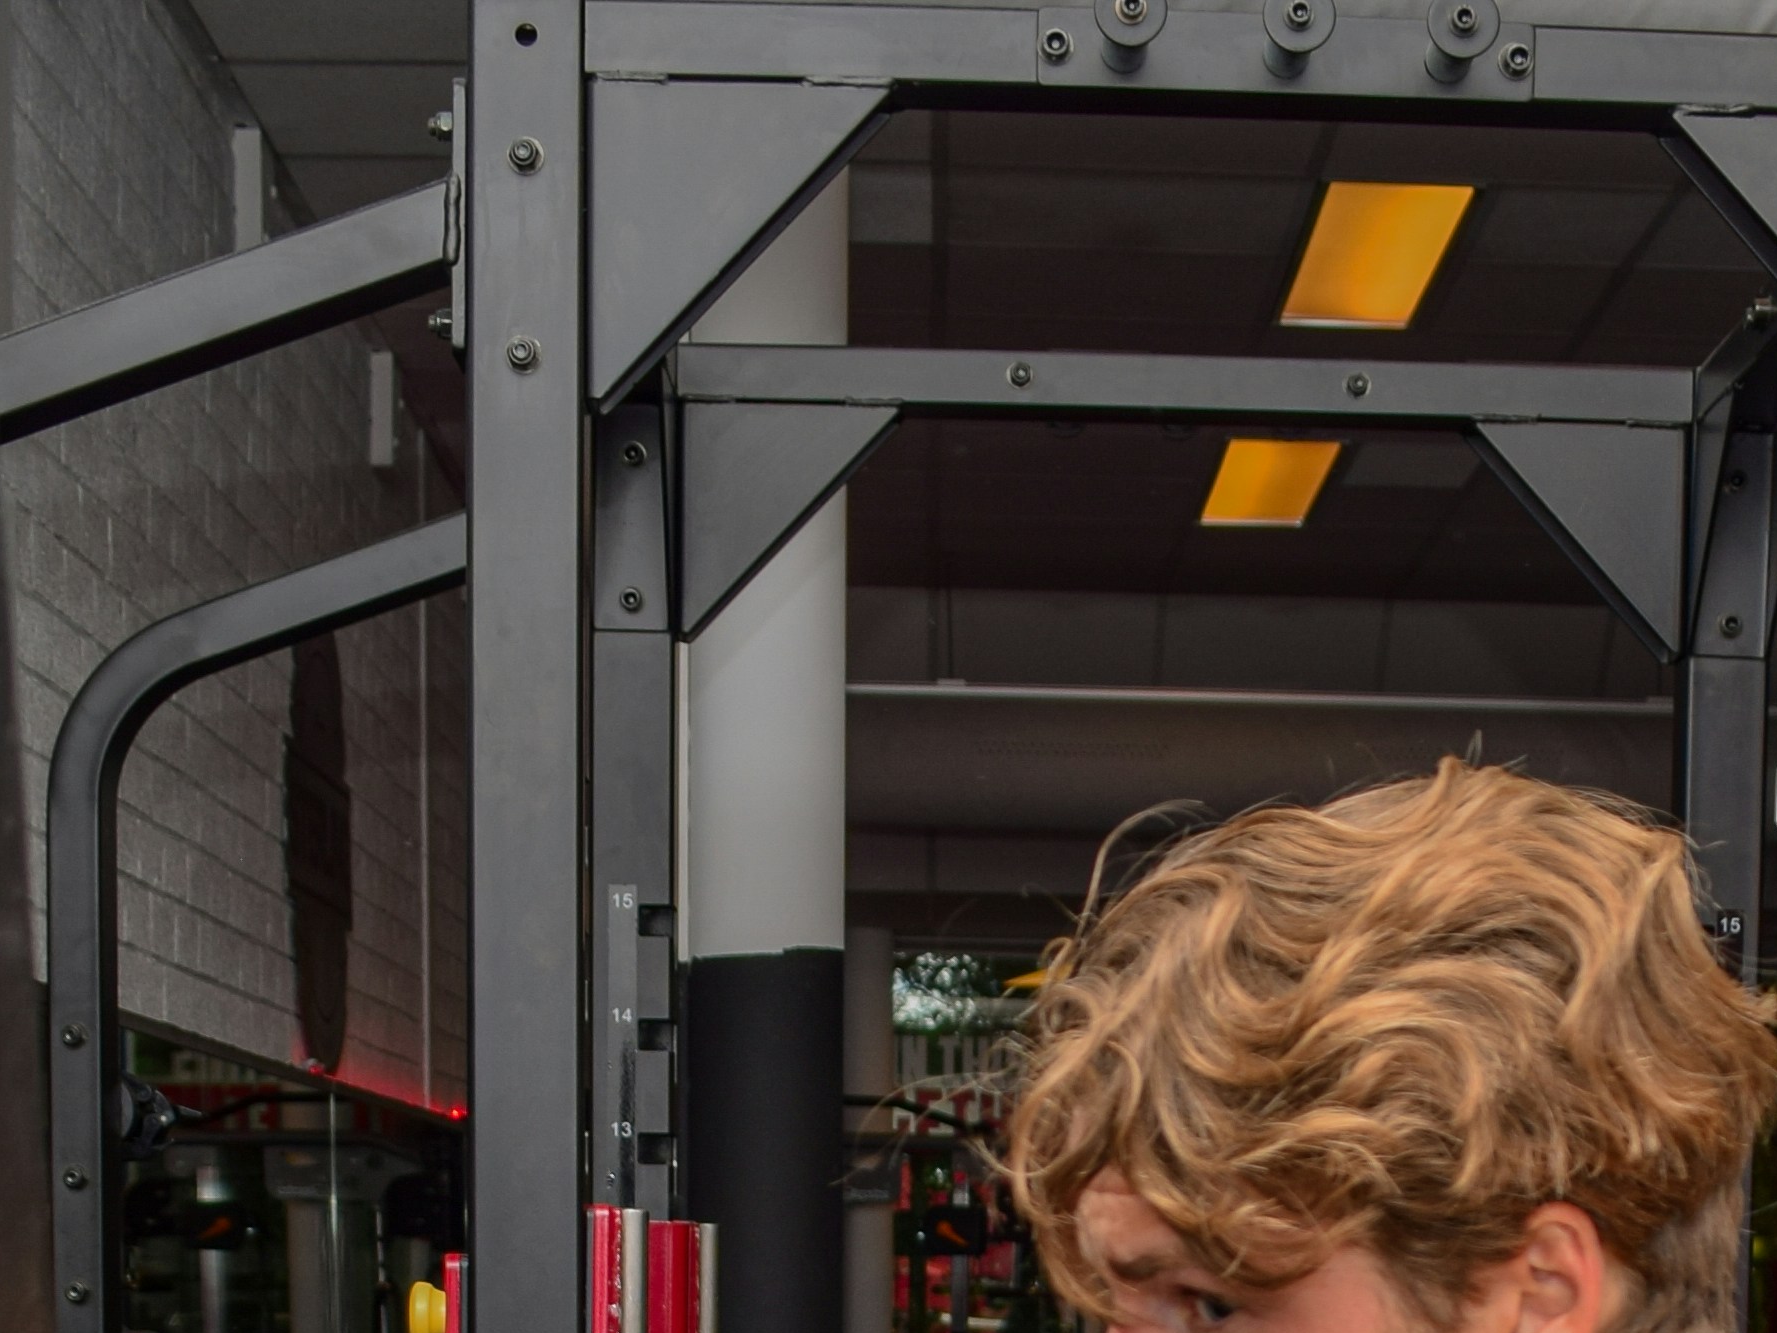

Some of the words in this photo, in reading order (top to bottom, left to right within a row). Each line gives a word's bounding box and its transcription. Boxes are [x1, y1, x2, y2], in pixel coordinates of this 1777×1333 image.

[613, 892, 633, 909] 15
[1720, 916, 1741, 934] 15
[612, 1007, 632, 1023] 14
[611, 1121, 632, 1137] 13
